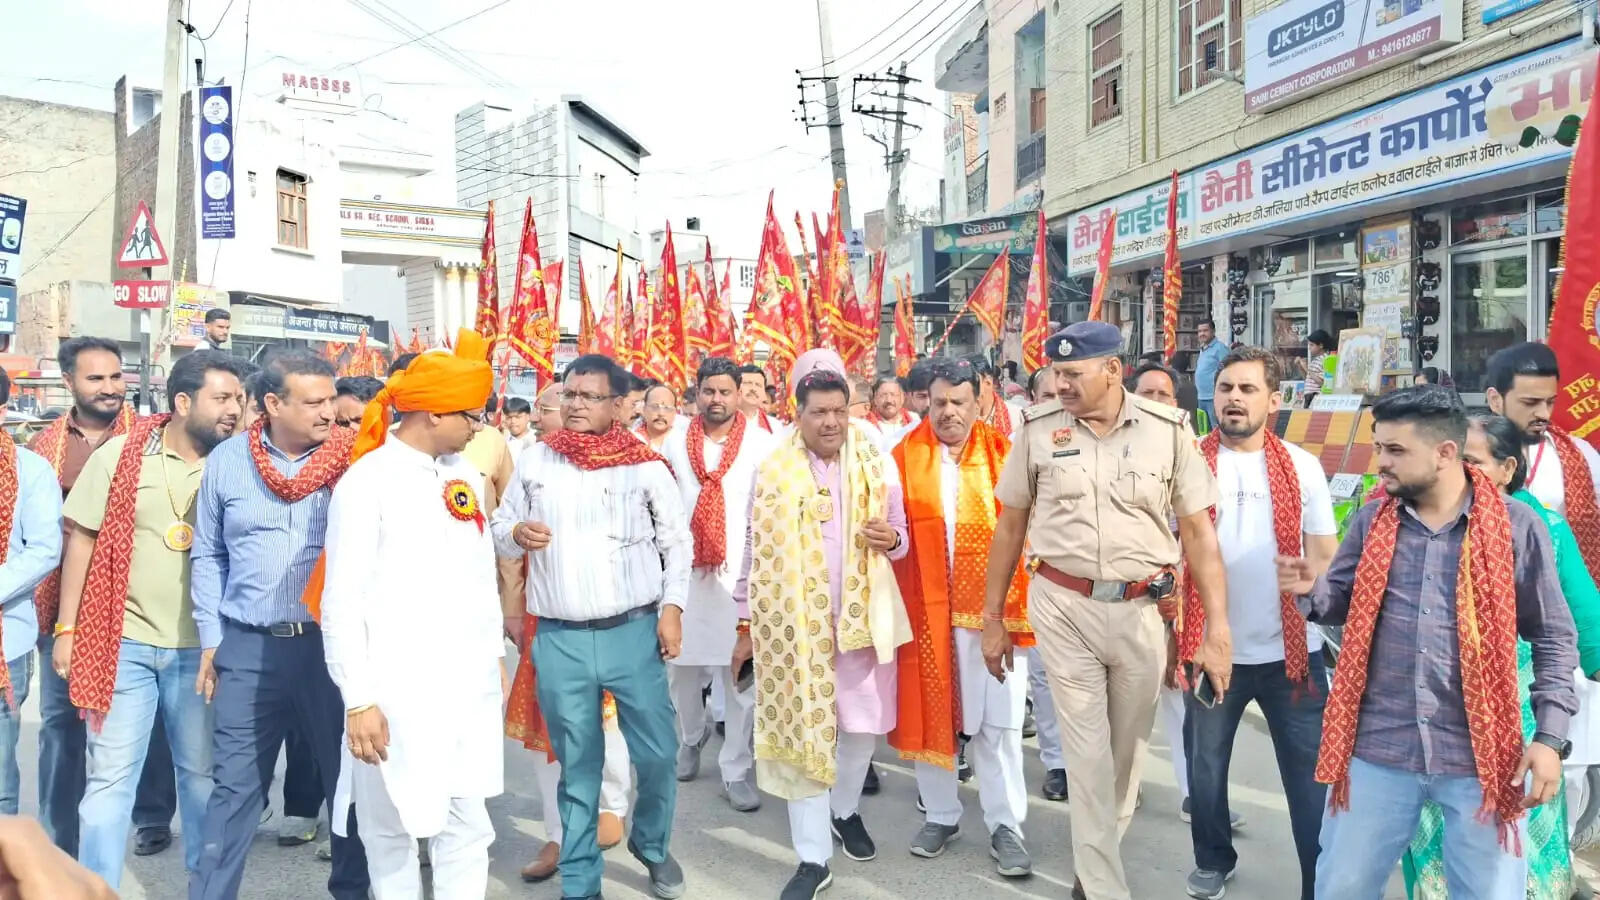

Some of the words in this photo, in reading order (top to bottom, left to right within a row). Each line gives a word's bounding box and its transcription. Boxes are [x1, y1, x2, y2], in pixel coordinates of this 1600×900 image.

[1272, 8, 1336, 51] JKTYLO
[1251, 92, 1269, 106] SAINI
[1270, 79, 1300, 98] CEMENT
[1299, 57, 1355, 88] CORPORATION
[1201, 159, 1253, 212] सैनी
[1261, 131, 1371, 195] सीमेन्ट
[114, 285, 130, 302] GO
[137, 285, 168, 303] SLOW
